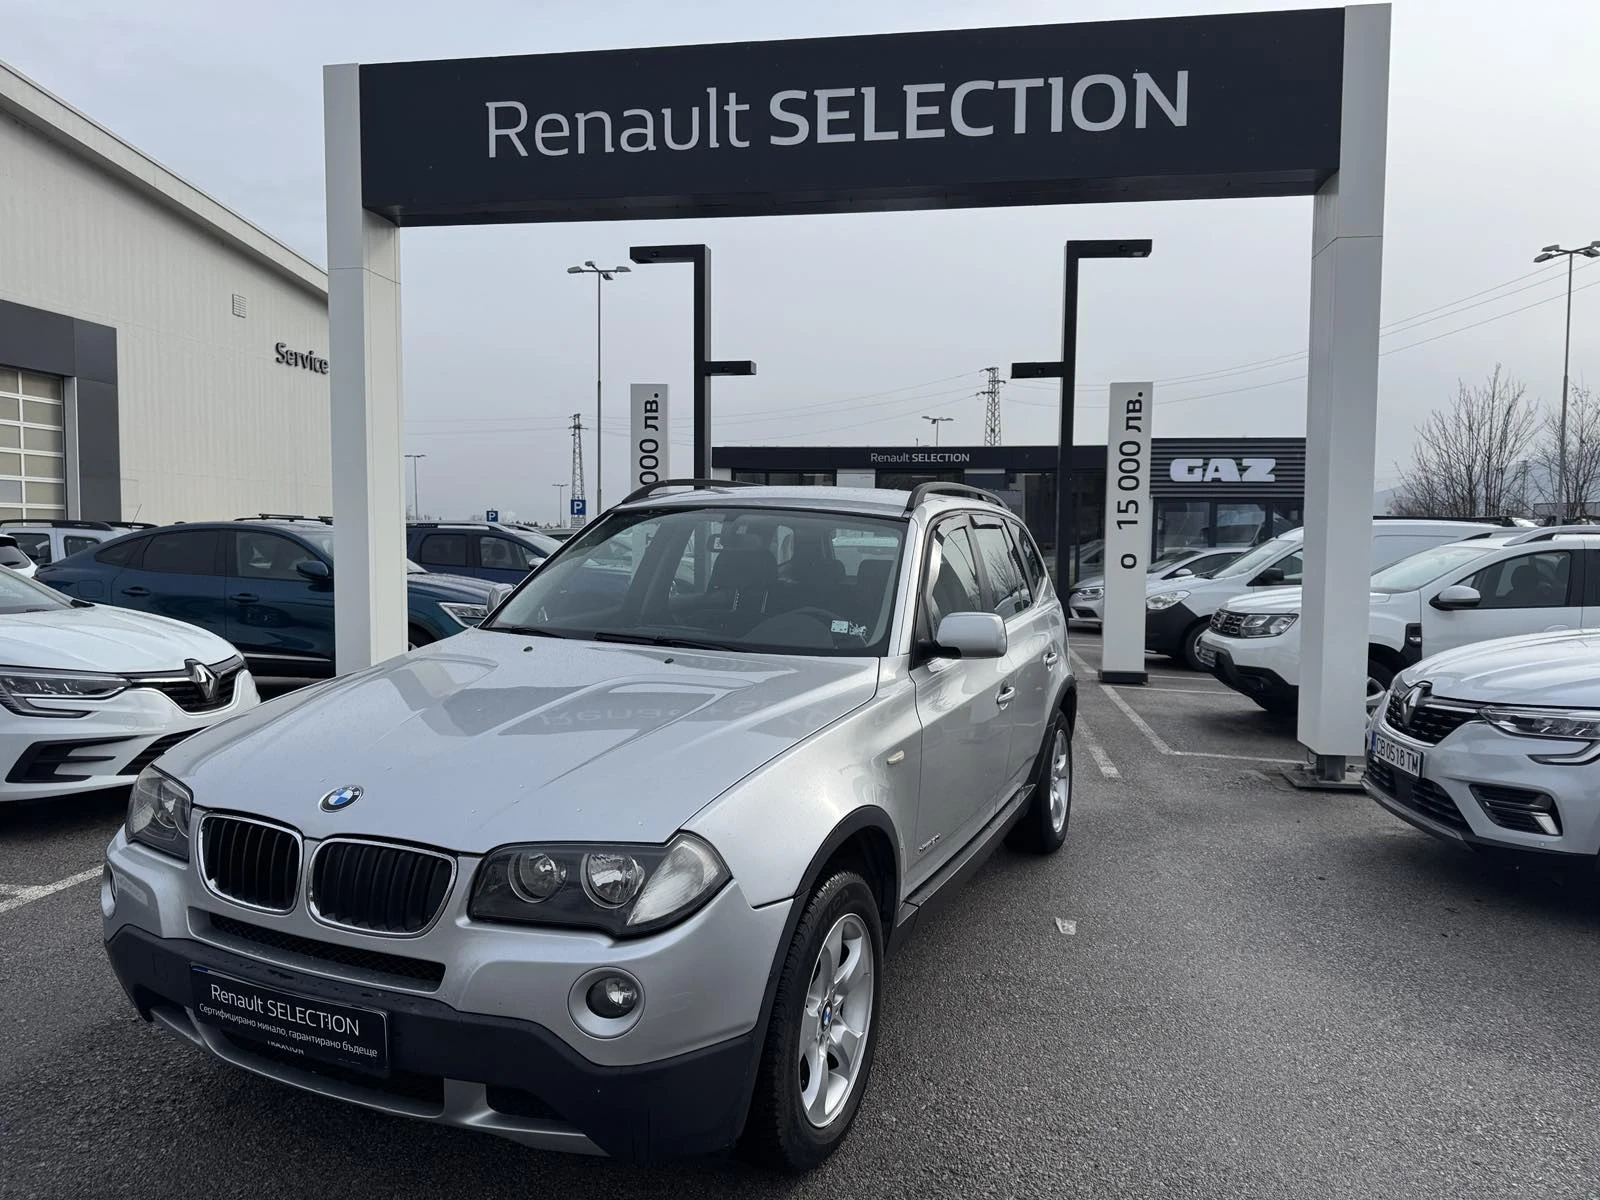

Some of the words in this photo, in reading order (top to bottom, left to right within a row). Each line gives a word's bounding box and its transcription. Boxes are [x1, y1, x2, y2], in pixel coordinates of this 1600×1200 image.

[485, 87, 750, 158] Renault
[769, 69, 1190, 147] SELECTION
[275, 342, 329, 375] Service
[644, 392, 659, 432] лв.
[1125, 391, 1144, 433] лв.
[870, 452, 910, 463] Renault
[911, 453, 970, 463] SELECTION
[1117, 440, 1142, 492] 000
[1169, 458, 1276, 482] GAZ
[573, 501, 583, 513] P
[1116, 499, 1139, 530] 15
[1406, 751, 1419, 775] TM
[211, 983, 264, 1014] Renault
[267, 1000, 359, 1036] SELECTION
[199, 1003, 257, 1027] Сертифицирано
[257, 1021, 288, 1037] минало,
[288, 1030, 341, 1049] гарантирано
[342, 1041, 378, 1057] бъдеще
